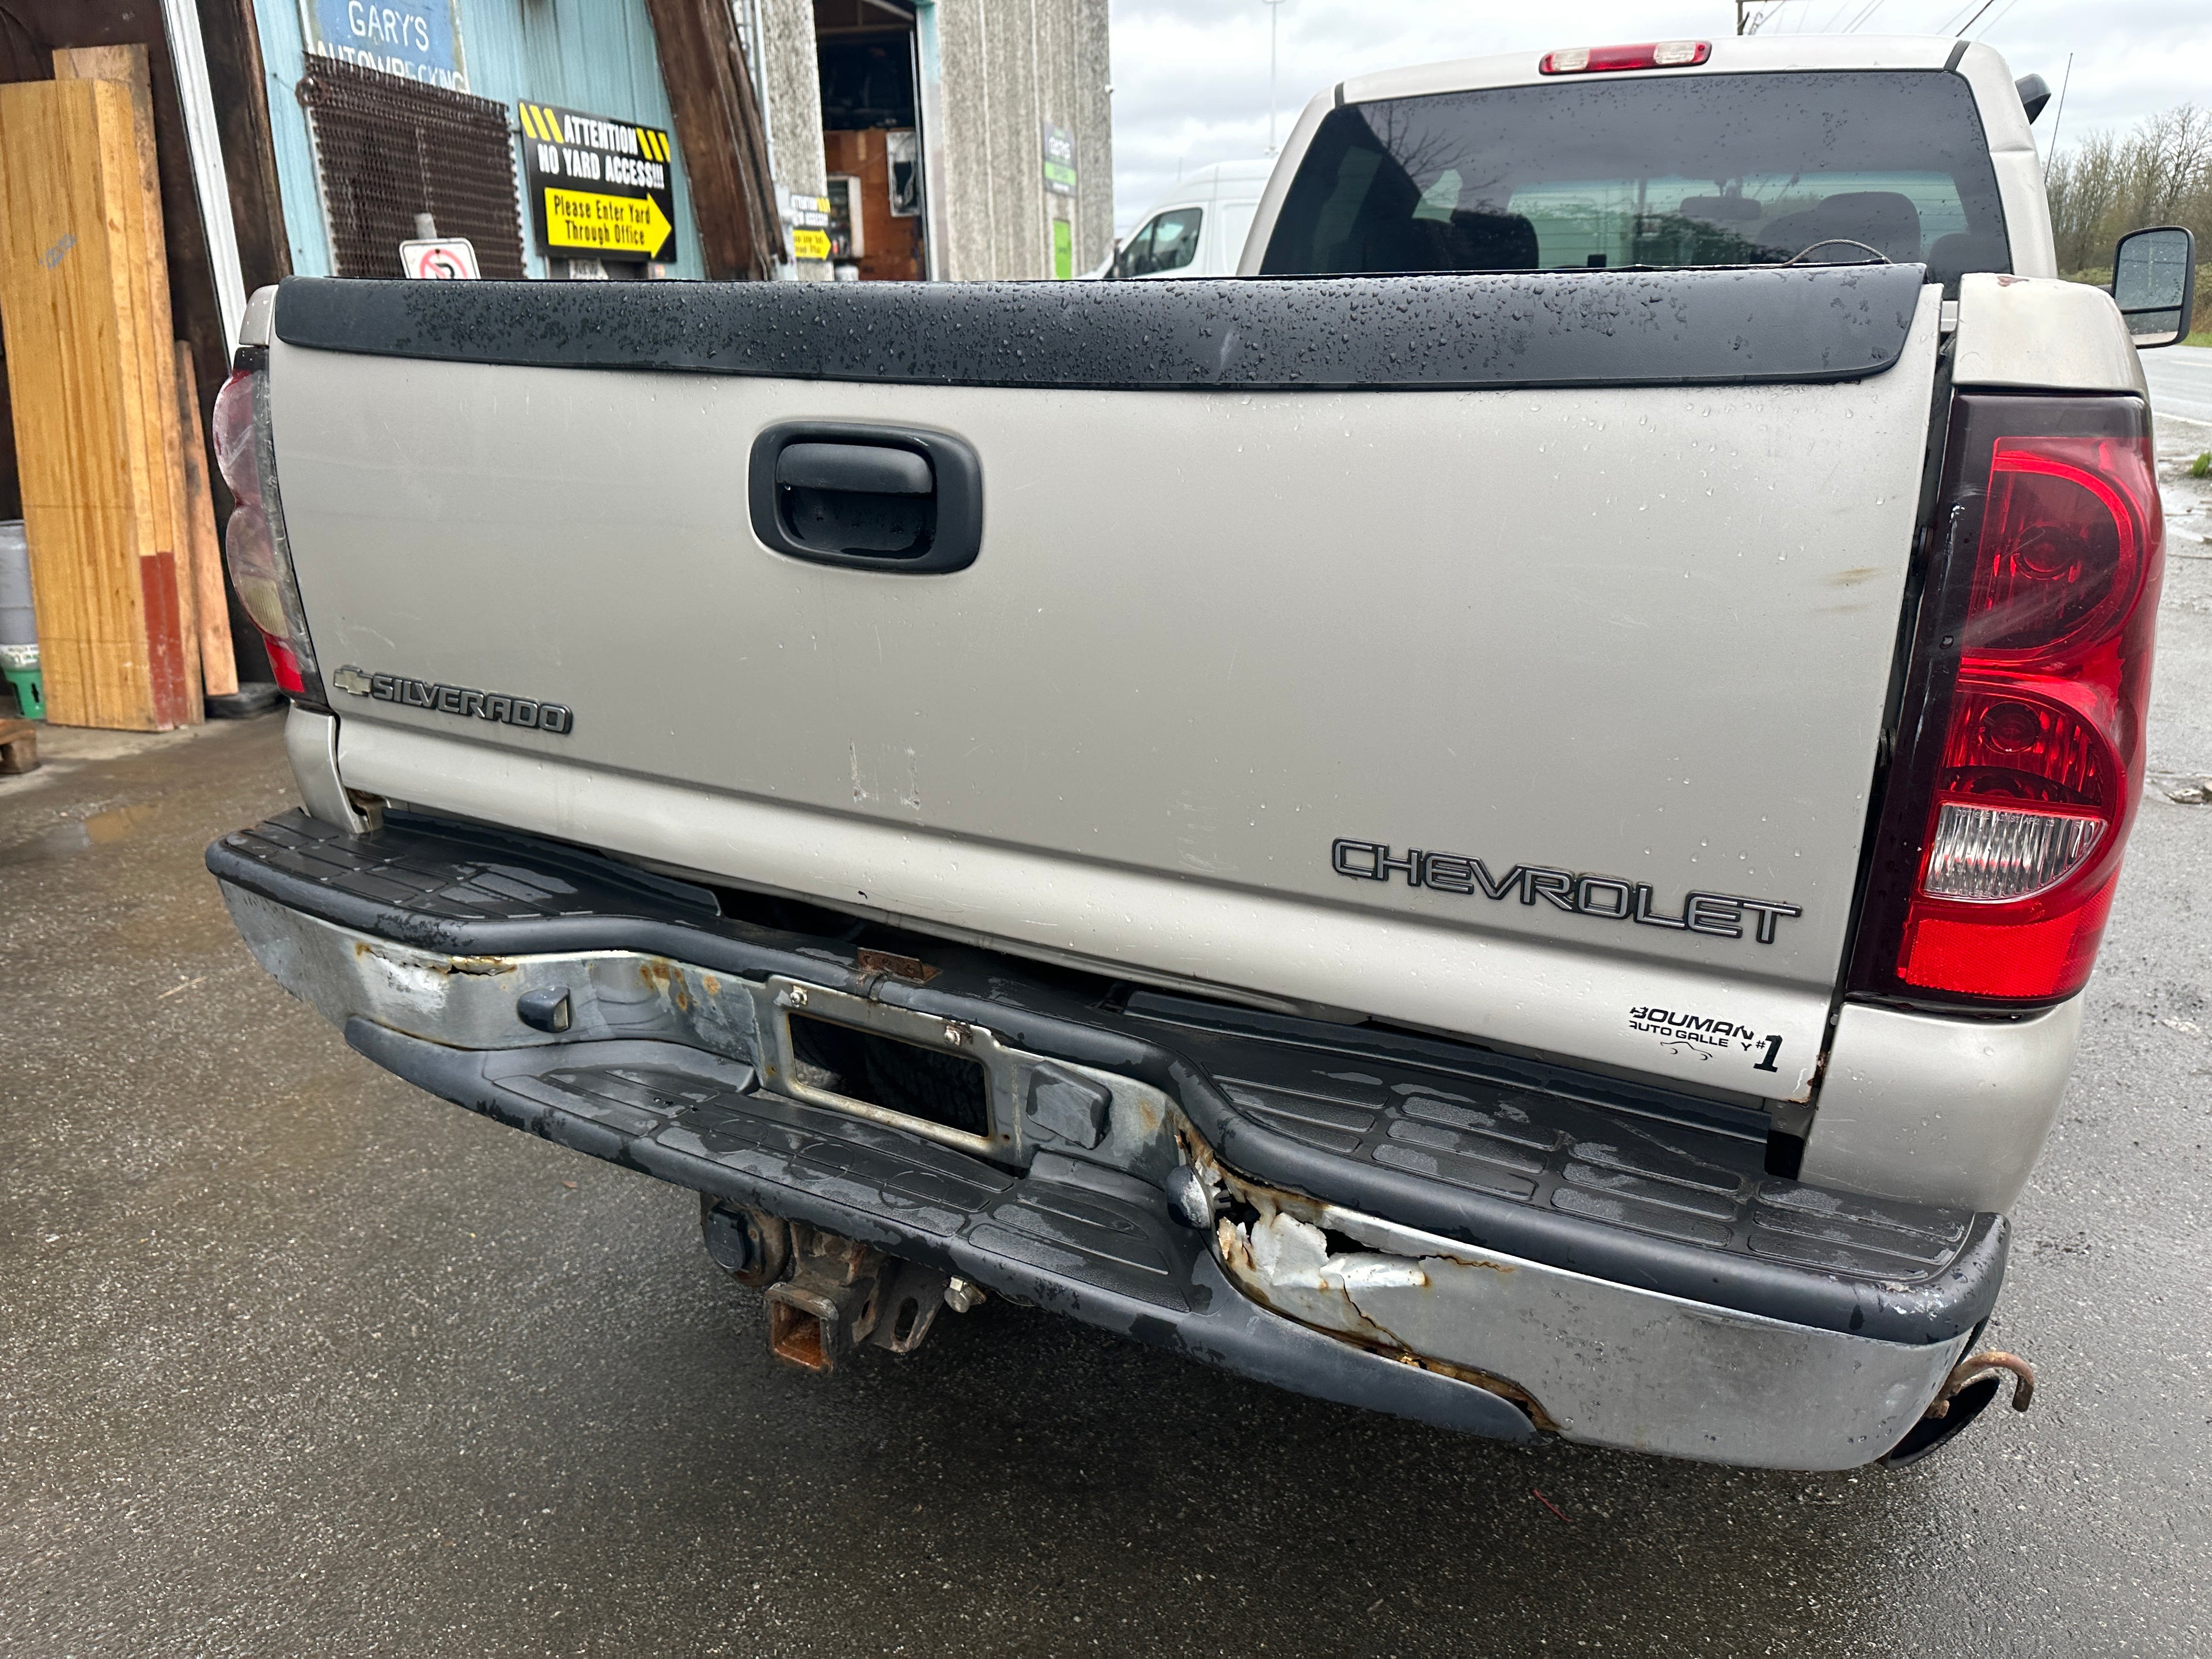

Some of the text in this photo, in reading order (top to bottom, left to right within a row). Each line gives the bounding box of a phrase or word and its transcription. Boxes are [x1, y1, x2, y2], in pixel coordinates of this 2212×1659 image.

[348, 0, 429, 52] GARY'S
[564, 115, 638, 156] ATTENTION
[537, 143, 665, 190] NO YARD ACCESS!!!
[554, 195, 650, 225] Please Enter Yard
[565, 220, 645, 247] Through Office
[372, 672, 573, 734] SILVERADO
[1332, 837, 1803, 944] CHEVROLET
[1629, 1006, 1754, 1040] BOUMAN
